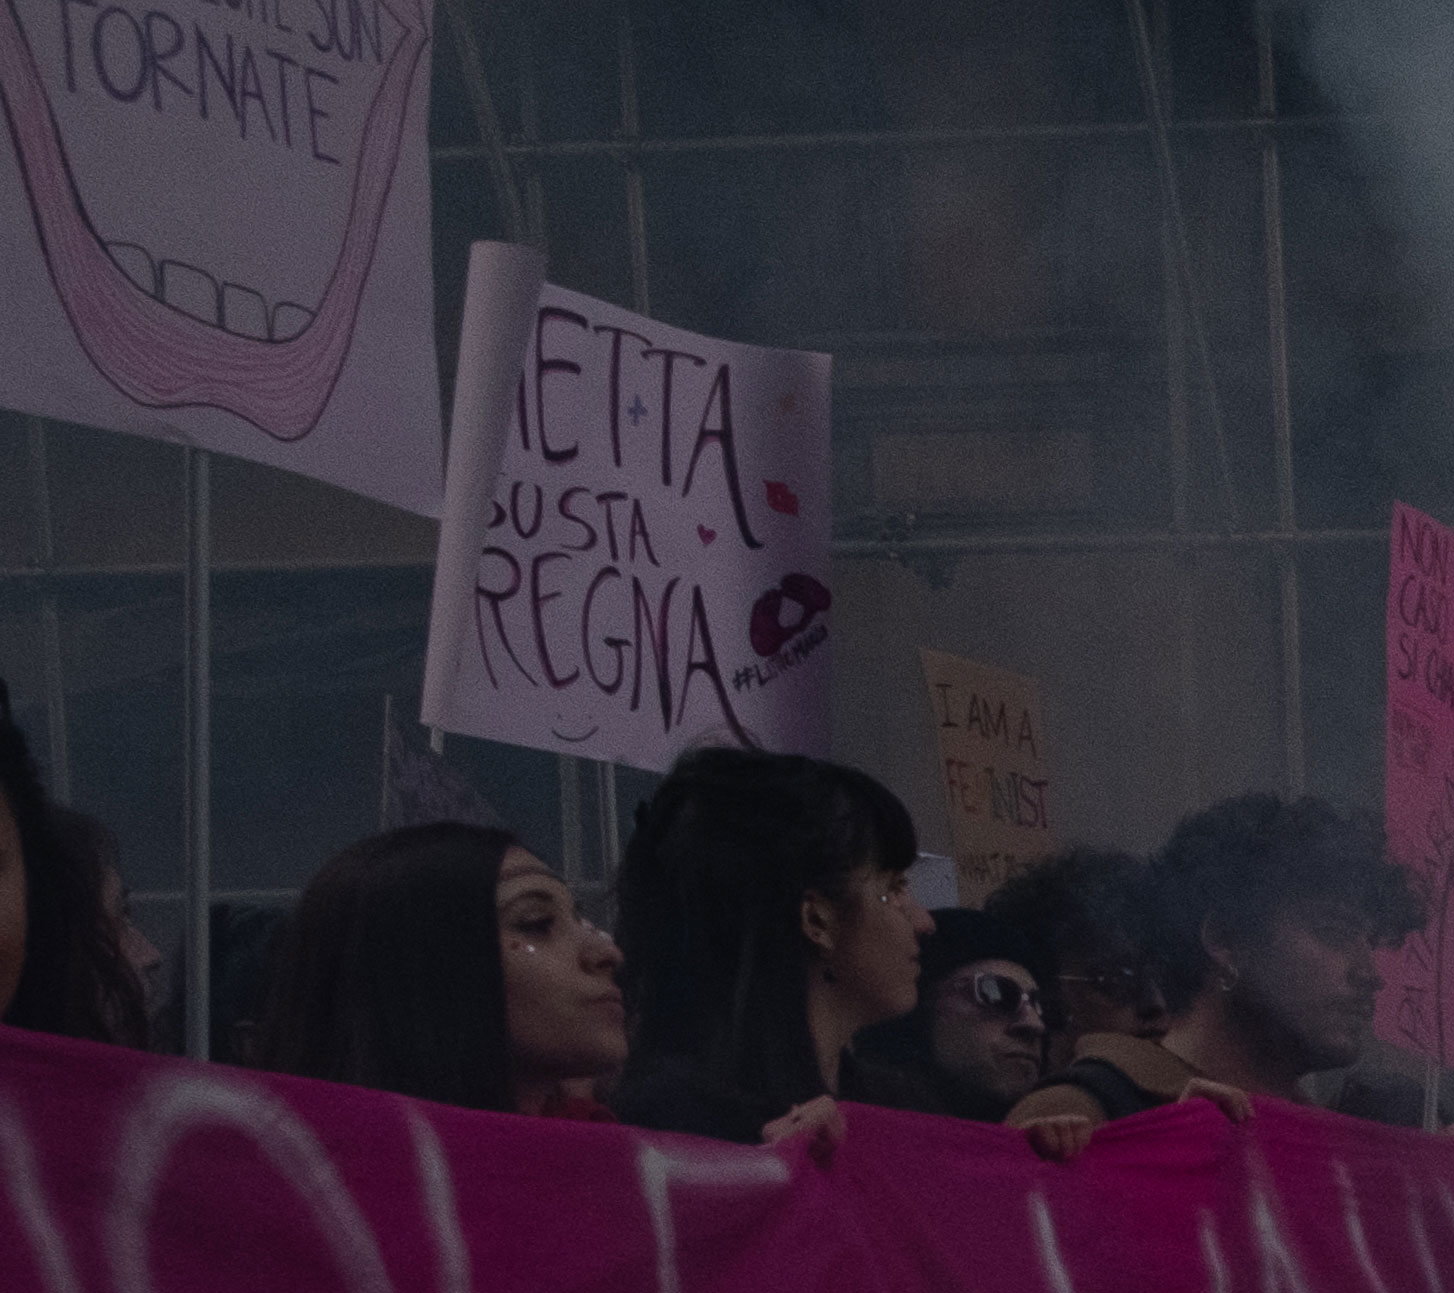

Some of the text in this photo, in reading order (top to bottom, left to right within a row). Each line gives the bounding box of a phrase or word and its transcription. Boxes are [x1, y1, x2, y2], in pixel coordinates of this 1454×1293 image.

[60, 0, 342, 166] TORNATE
[488, 480, 661, 568] USTA
[474, 546, 756, 748] REGNA
[935, 683, 1038, 760] I AM A
